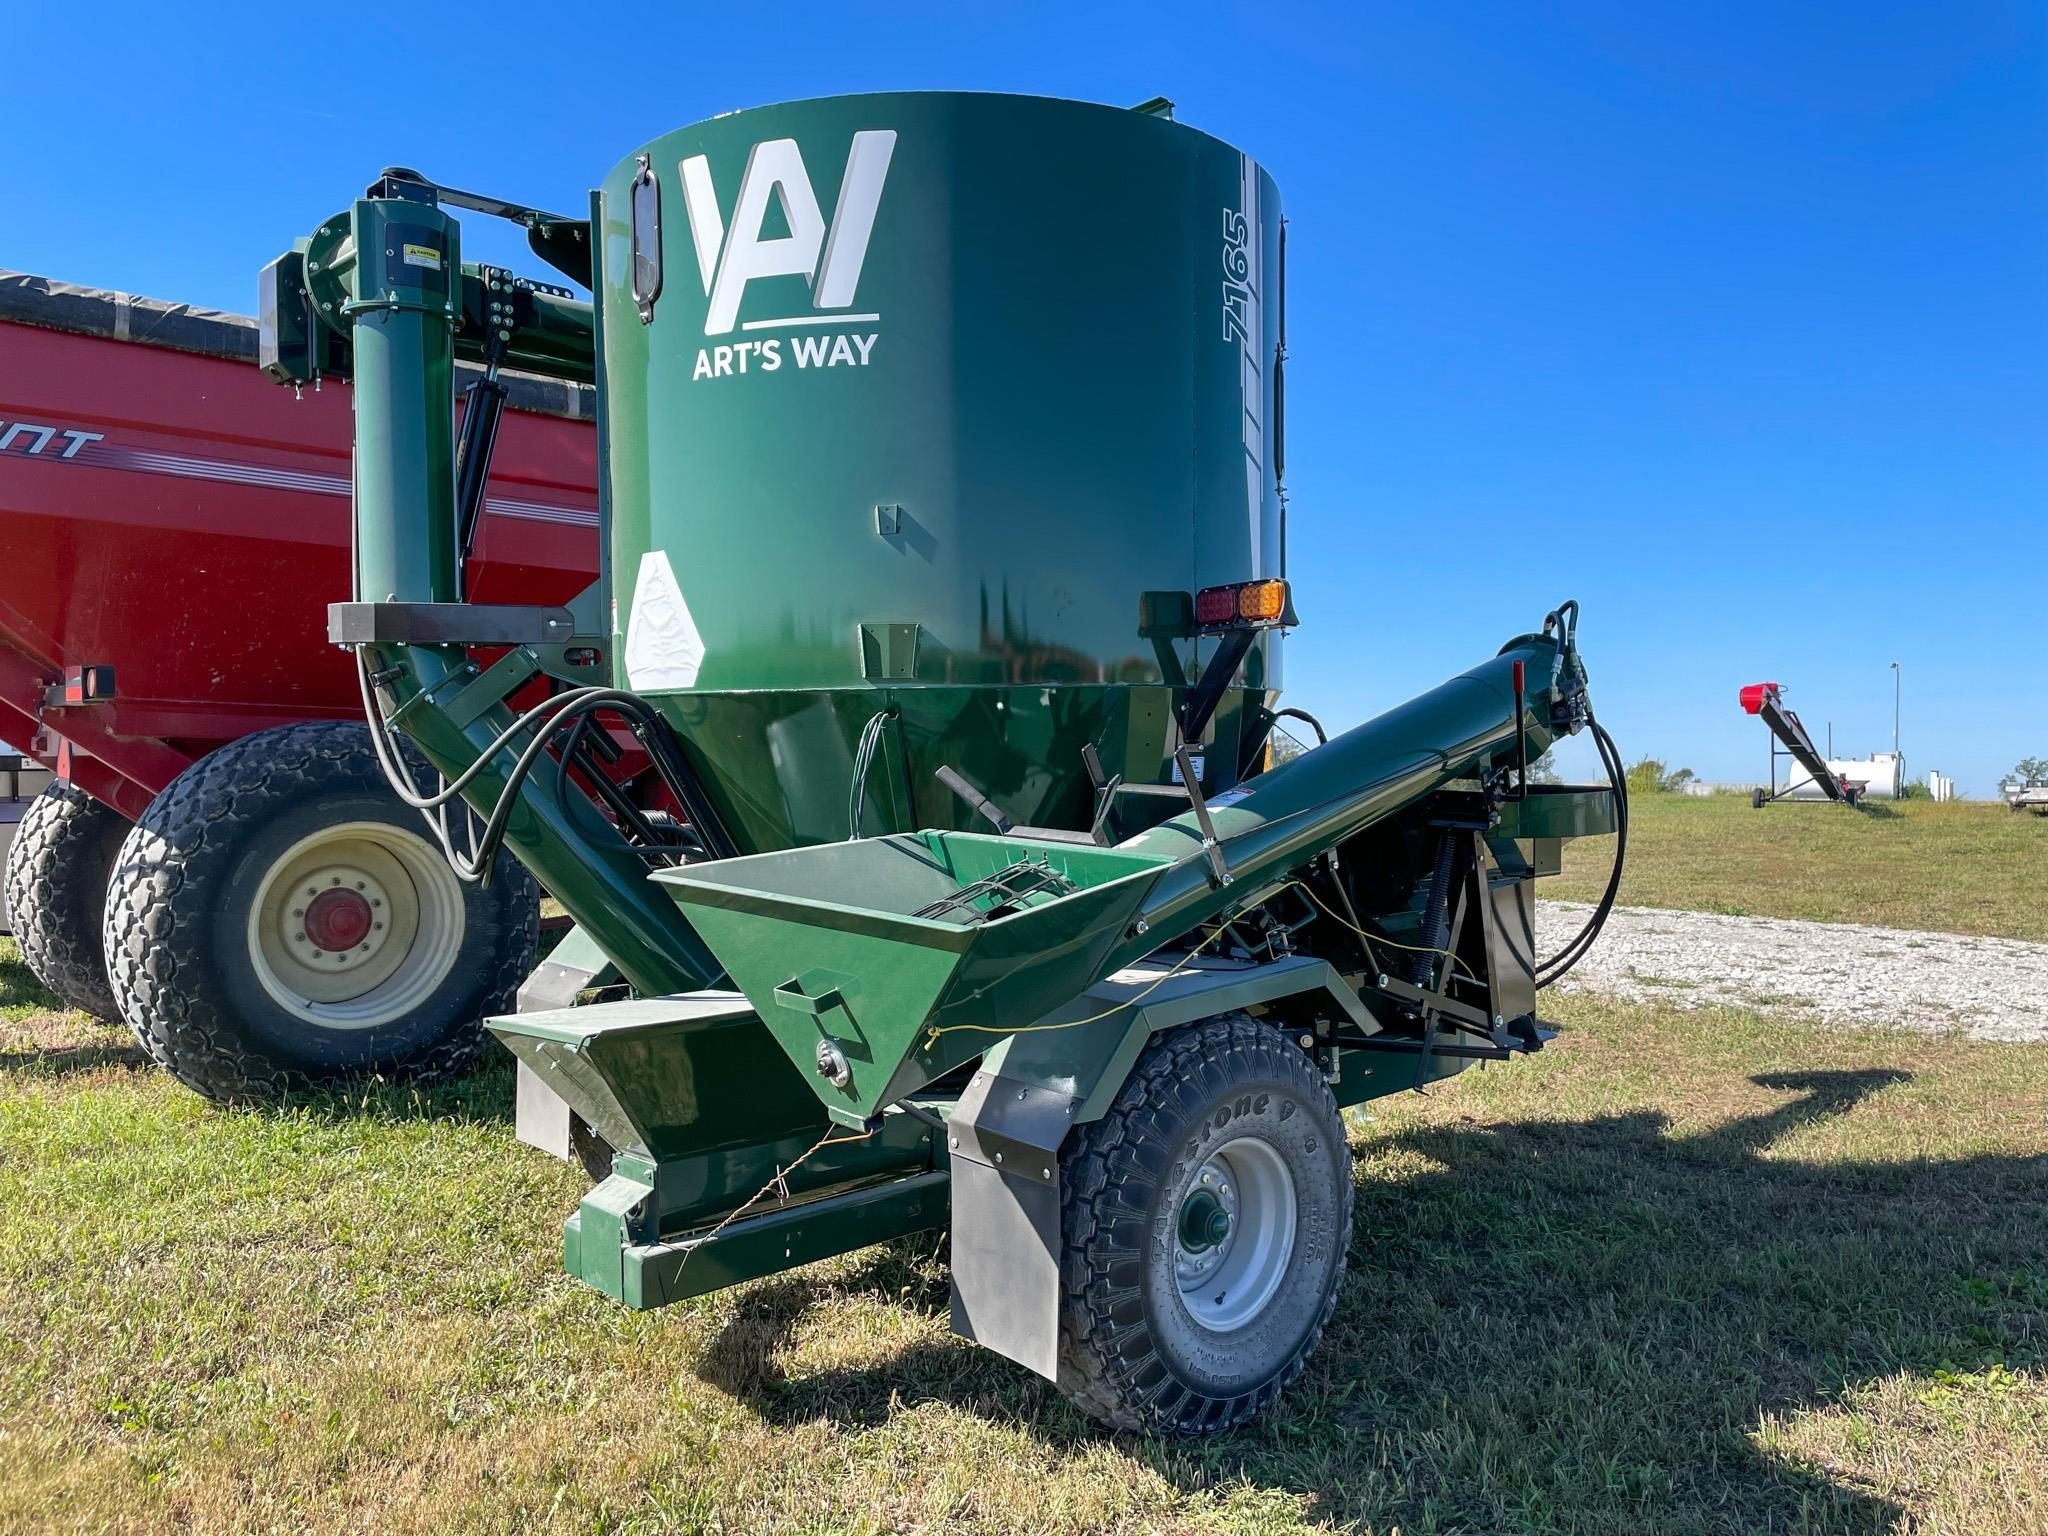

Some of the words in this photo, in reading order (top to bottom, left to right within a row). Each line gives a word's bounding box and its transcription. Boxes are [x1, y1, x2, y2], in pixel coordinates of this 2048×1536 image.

[1222, 208, 1249, 343] 7165
[692, 339, 782, 381] ART'S
[790, 333, 879, 369] WAY
